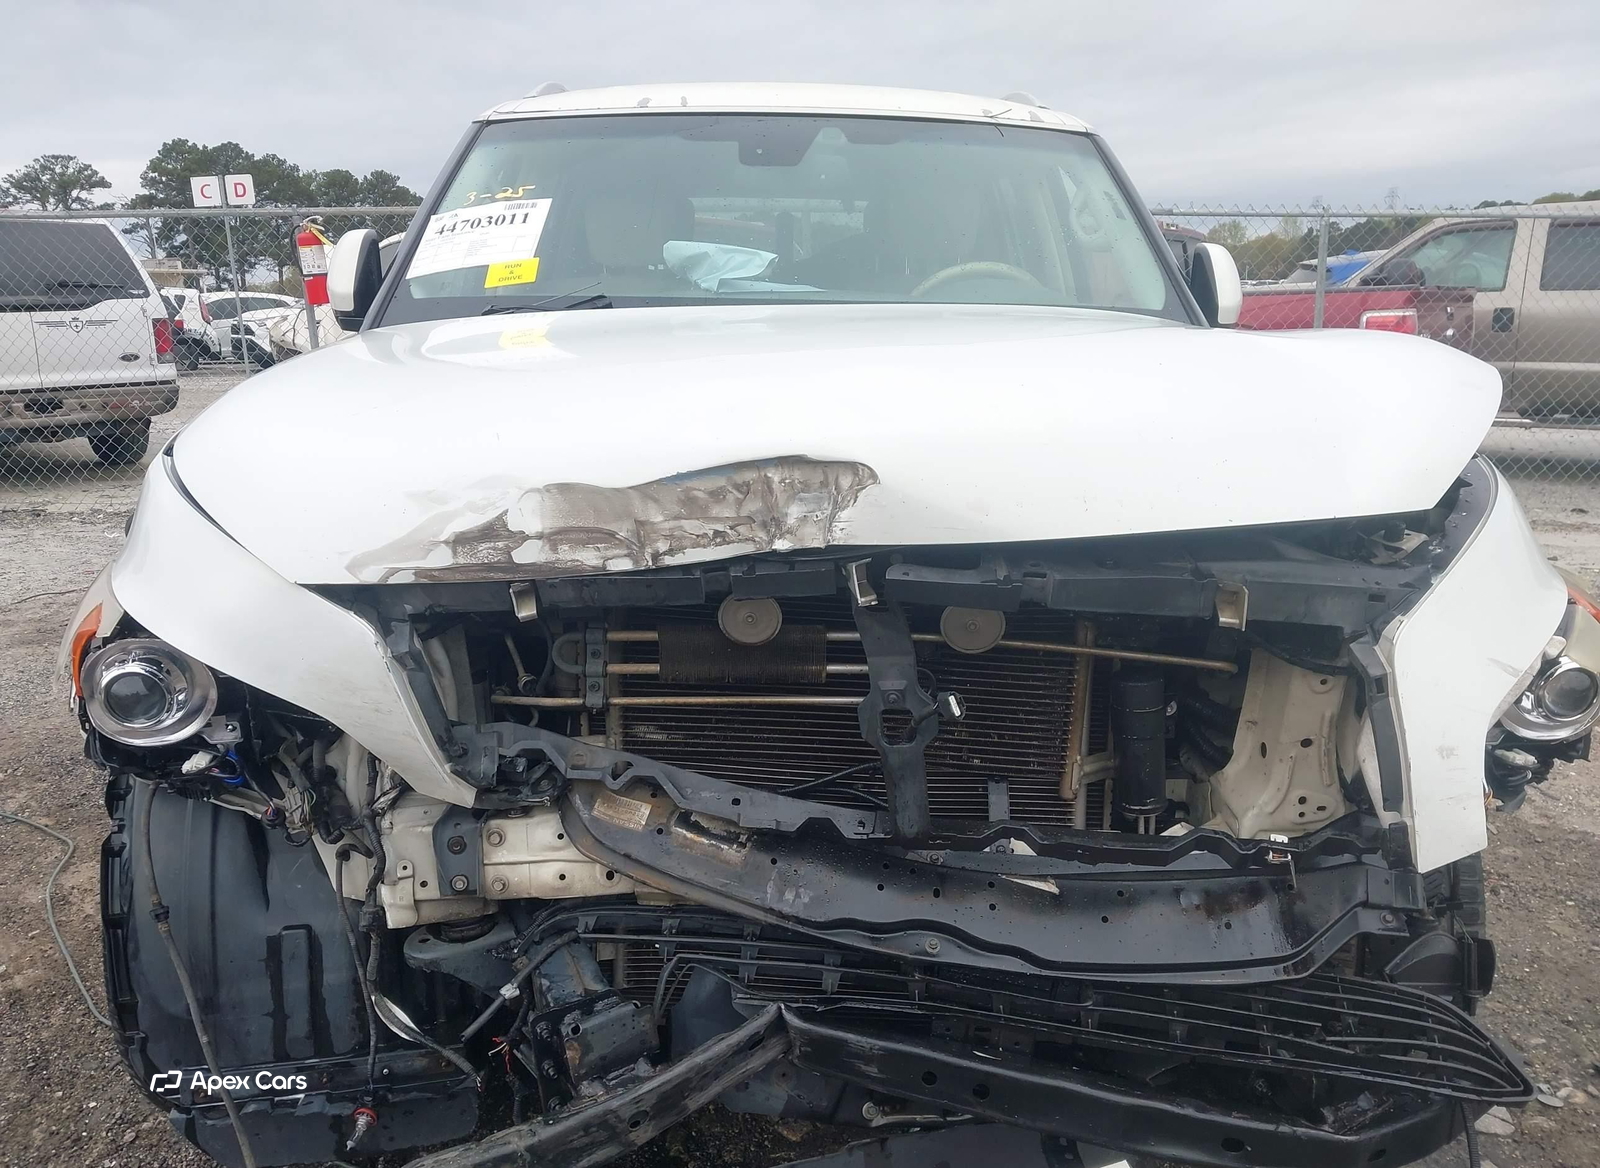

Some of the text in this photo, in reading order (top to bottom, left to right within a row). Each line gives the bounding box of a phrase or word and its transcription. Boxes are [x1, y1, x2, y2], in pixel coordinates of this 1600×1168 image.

[200, 183, 213, 199] C
[233, 182, 247, 198] D
[463, 185, 536, 206] 3-25
[434, 212, 530, 236] 44703011
[498, 274, 523, 283] DRIVE
[612, 817, 643, 830] NISSAN
